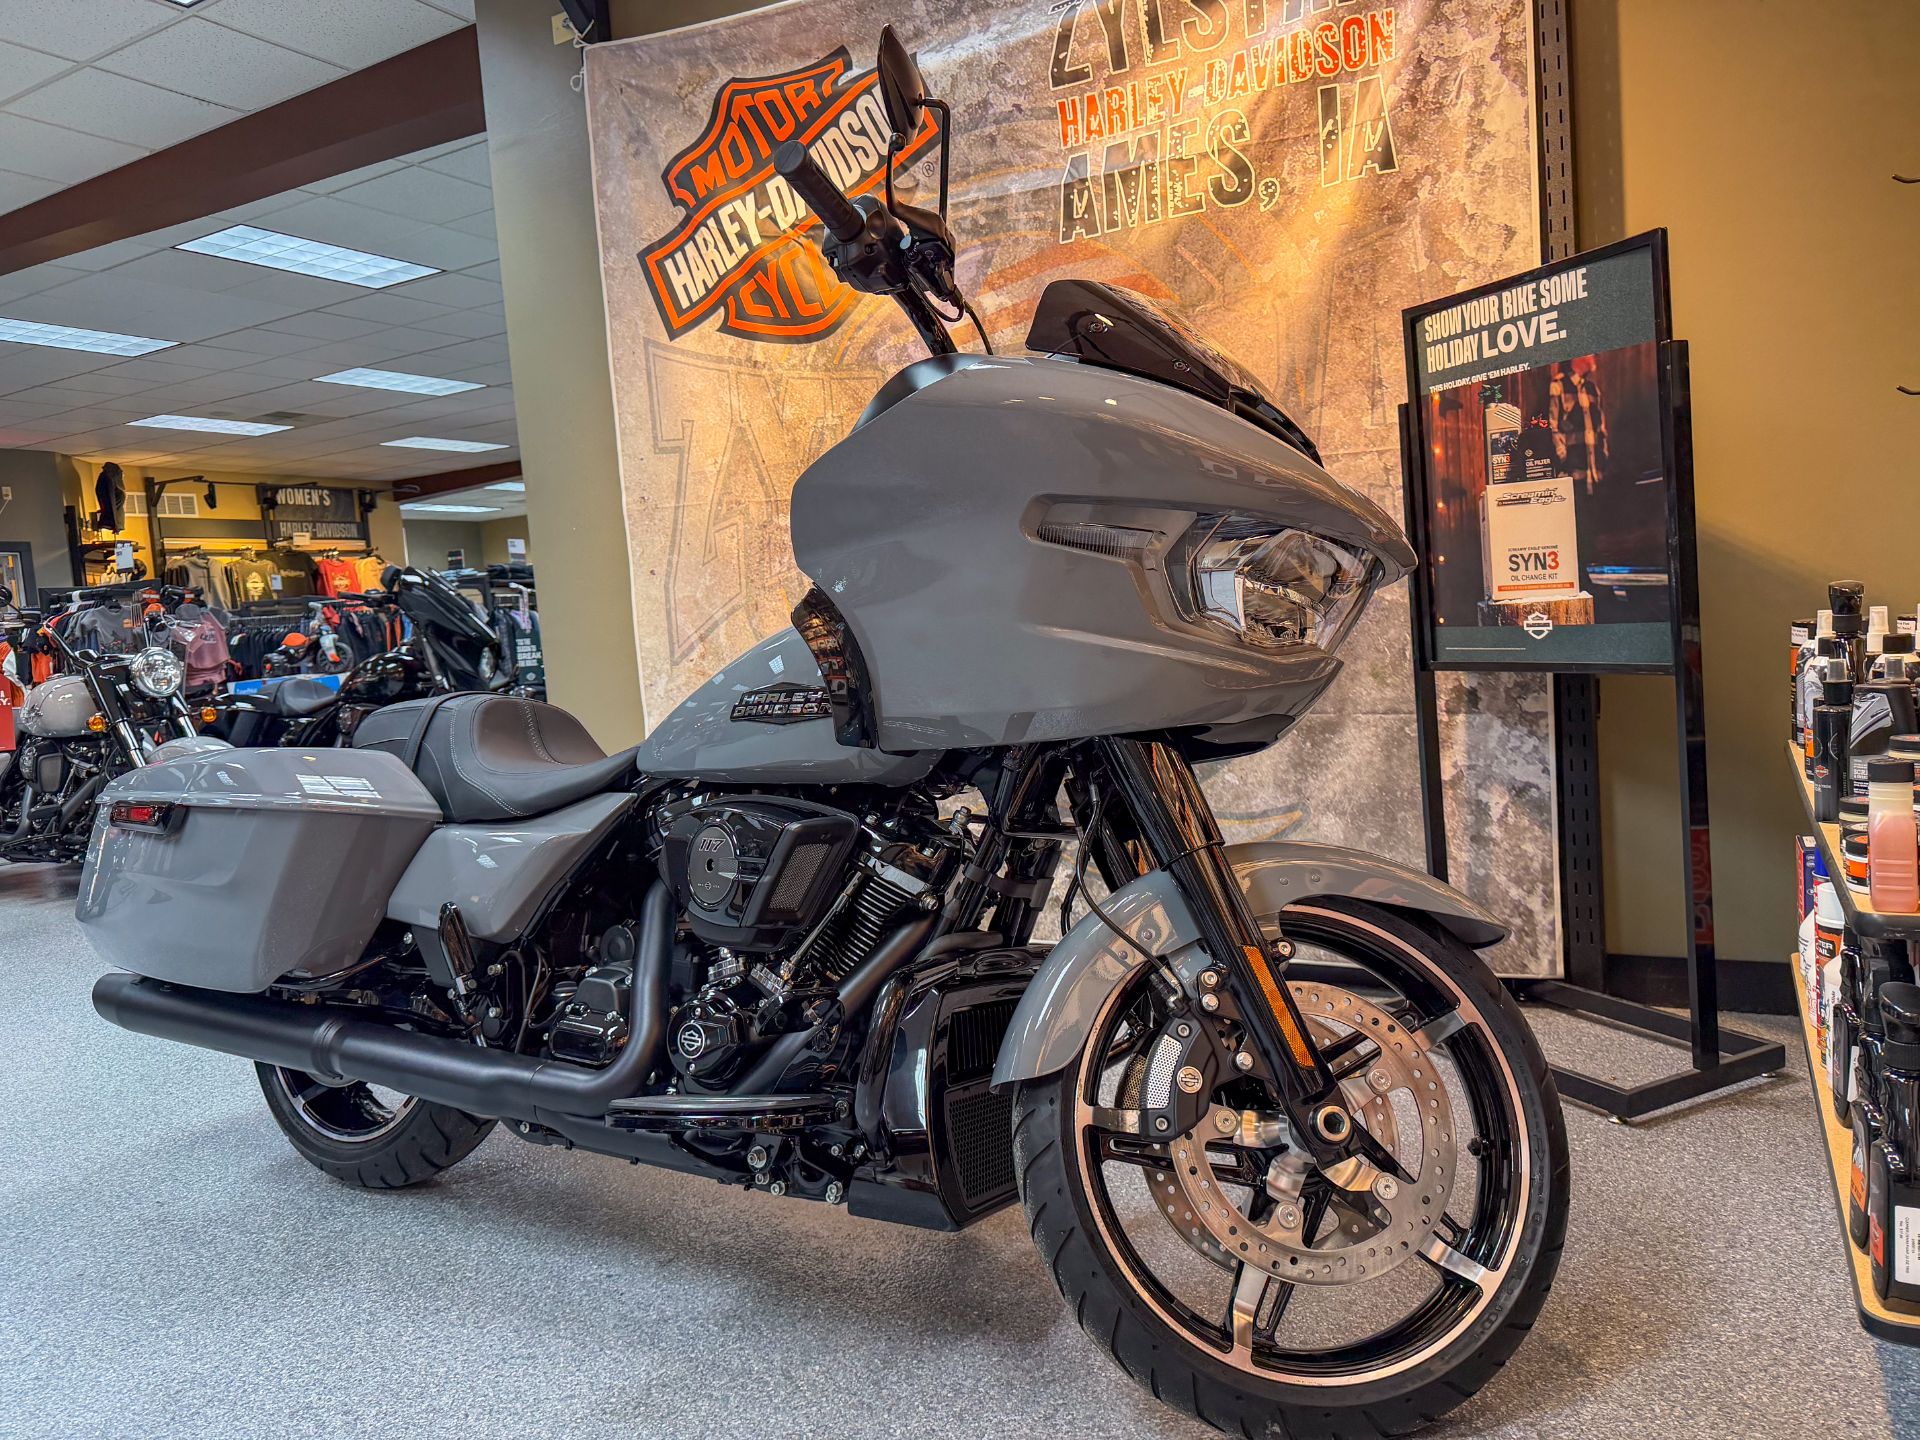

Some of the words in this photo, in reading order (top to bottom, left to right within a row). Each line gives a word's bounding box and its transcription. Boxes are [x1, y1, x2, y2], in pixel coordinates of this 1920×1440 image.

[1057, 8, 1397, 148] HARLEY-DAVIDSON
[690, 78, 820, 197] MOTOR
[1058, 108, 1281, 244] AMES,
[1317, 74, 1399, 188] IA
[1424, 309, 1462, 343] SHOW
[1461, 295, 1500, 329] YOUR
[1502, 282, 1537, 320] BIKE
[1540, 268, 1587, 309] SOME
[1426, 333, 1479, 373] HOLIDAY
[1481, 311, 1567, 358] LOVE.
[1429, 384, 1444, 393] THIS
[1443, 377, 1472, 390] HOLIDAY,
[1471, 373, 1488, 383] GIVE
[1500, 363, 1531, 376] HARLEY.
[1492, 455, 1510, 464] SYN3
[277, 488, 331, 506] WOMEN'S
[280, 522, 358, 538] HARLEY-DAVIDSON
[1508, 551, 1559, 572] SYN3
[1521, 573, 1547, 581] CHANGE
